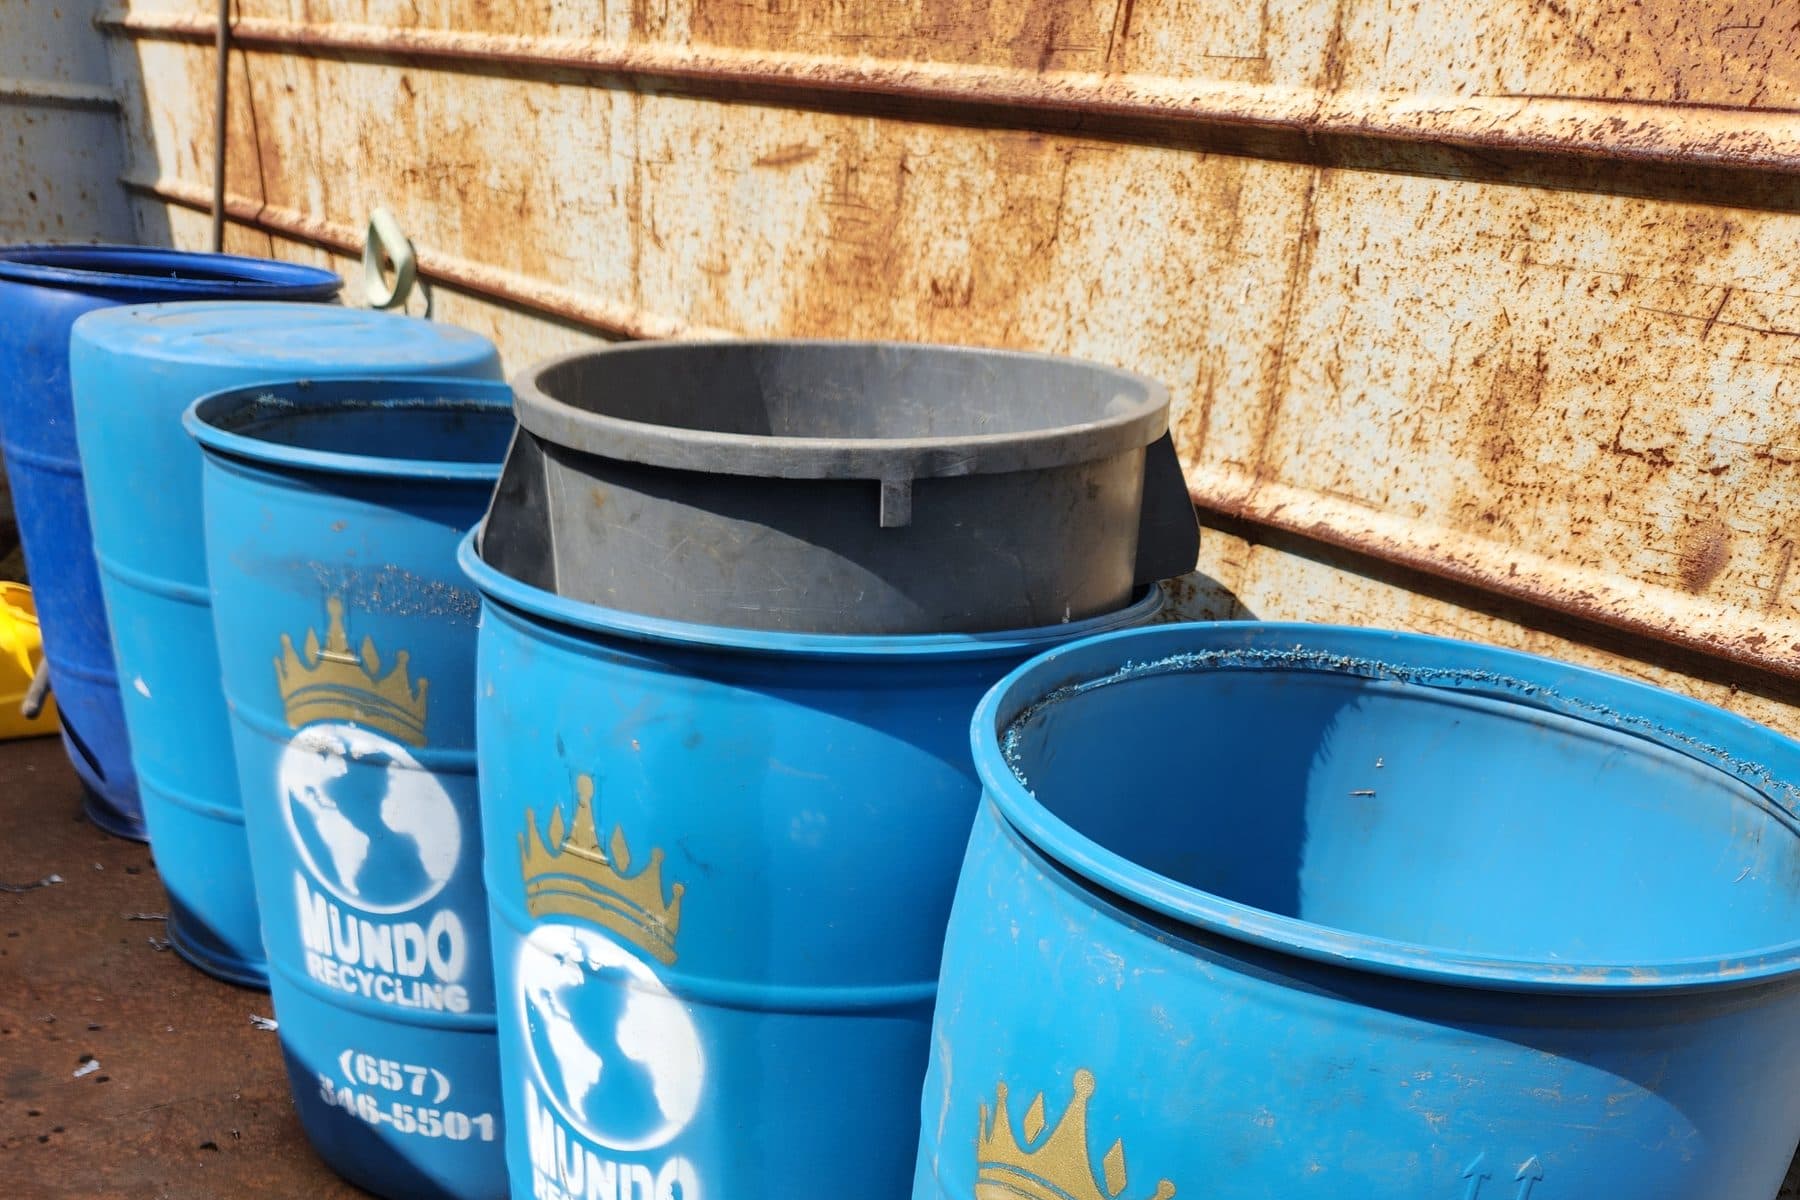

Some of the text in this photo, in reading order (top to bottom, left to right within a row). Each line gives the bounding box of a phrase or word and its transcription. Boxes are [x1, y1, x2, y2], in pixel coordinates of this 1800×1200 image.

[295, 870, 466, 983] MUNDO
[305, 951, 469, 1013] RECYCLING
[339, 1049, 451, 1104] (657)
